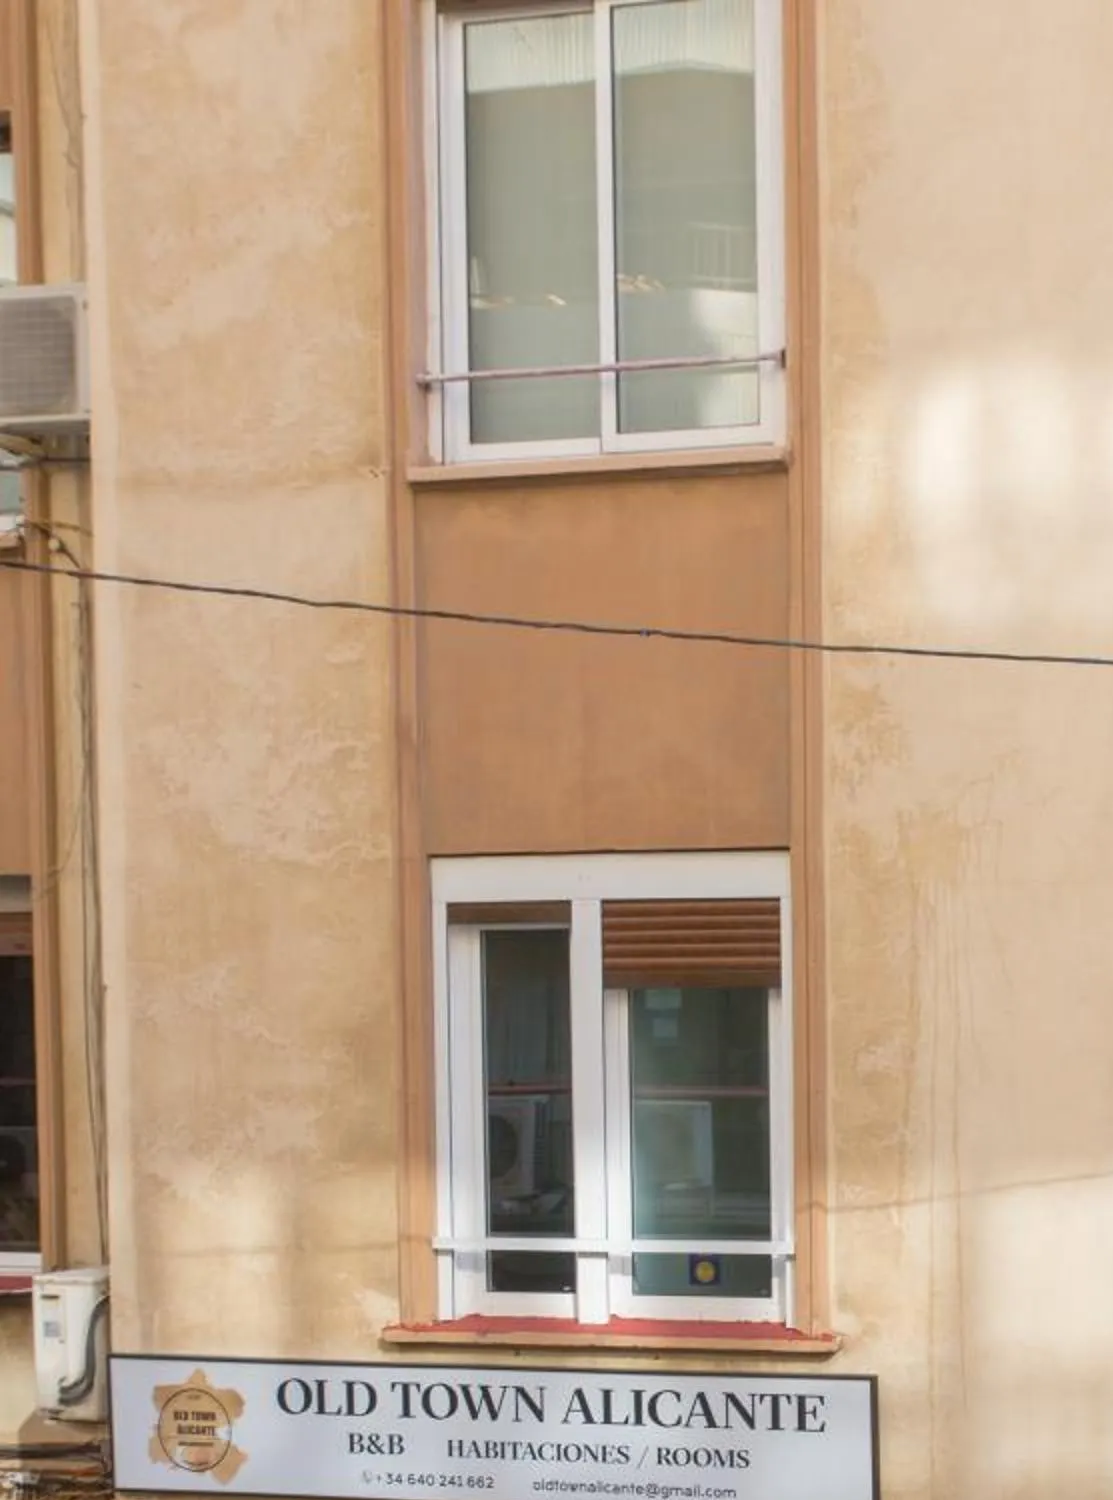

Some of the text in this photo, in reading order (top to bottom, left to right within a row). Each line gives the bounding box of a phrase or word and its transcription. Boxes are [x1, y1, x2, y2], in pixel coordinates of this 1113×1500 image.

[277, 1377, 827, 1433] OLD TOWN ALICANTE
[348, 1432, 751, 1469] B&B HABITACIONES / ROOMS
[407, 1473, 435, 1487] 640
[532, 1477, 737, 1500] oldtownalicante@gmail.com
